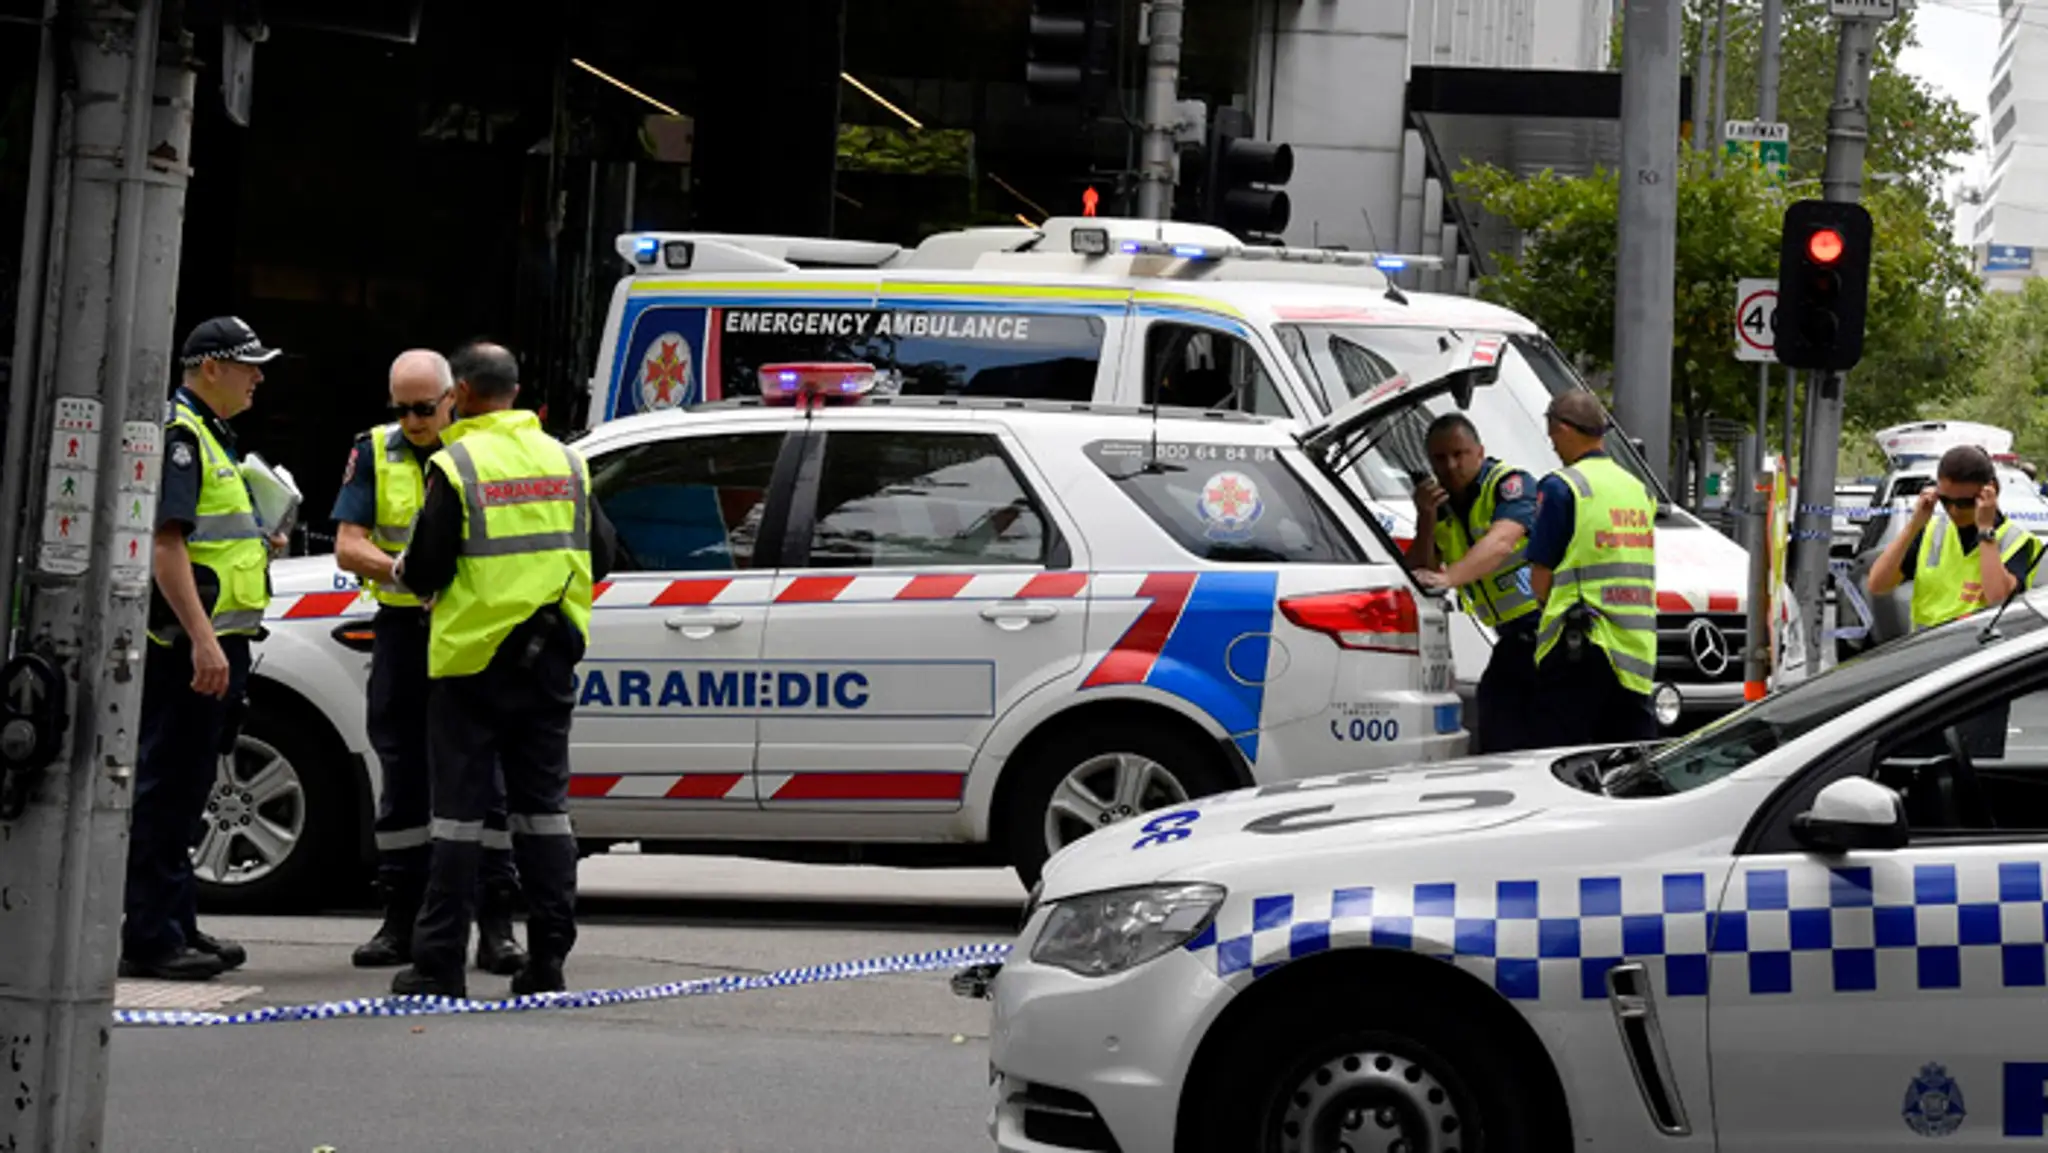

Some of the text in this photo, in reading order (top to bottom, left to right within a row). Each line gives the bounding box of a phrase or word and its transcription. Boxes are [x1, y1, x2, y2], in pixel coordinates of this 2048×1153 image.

[725, 311, 1029, 340] EMERGENCY AMBULANCE
[1349, 718, 1399, 742] 000
